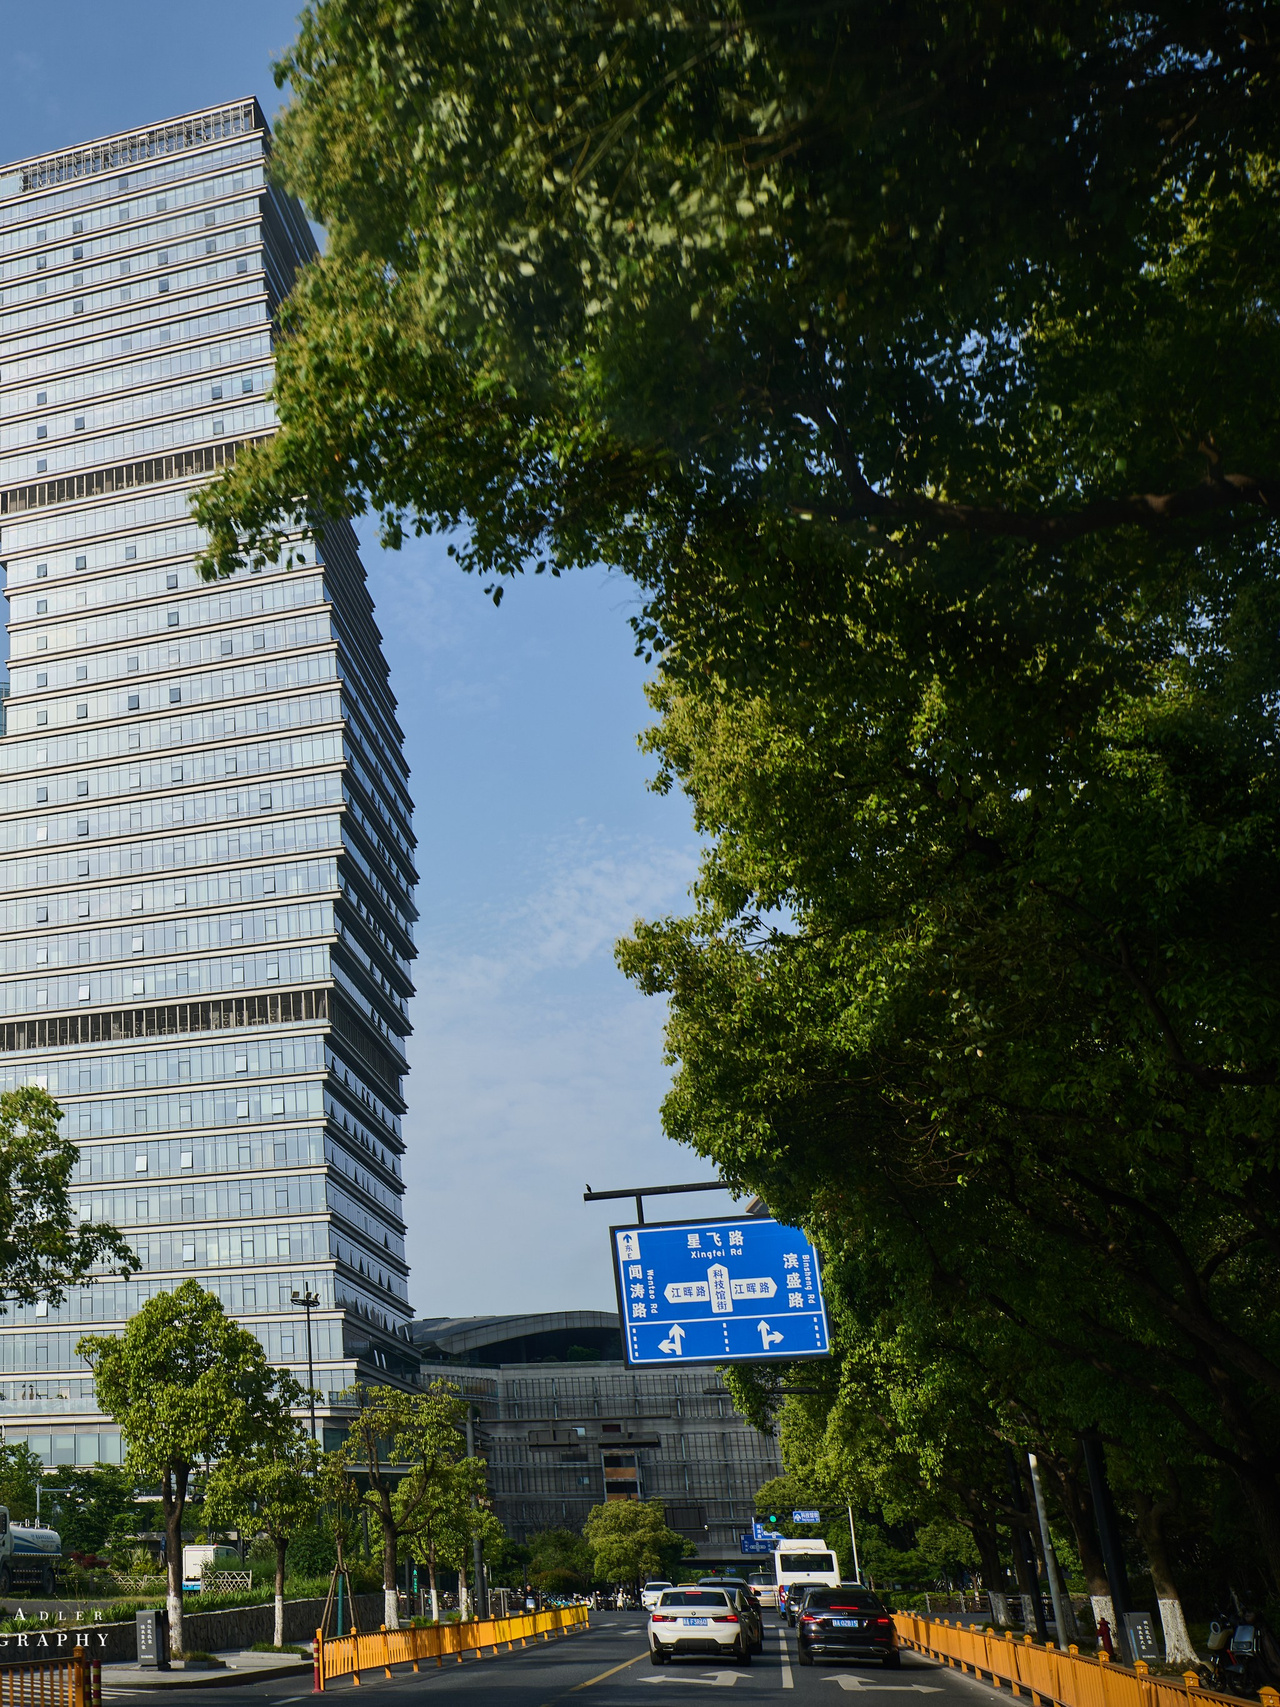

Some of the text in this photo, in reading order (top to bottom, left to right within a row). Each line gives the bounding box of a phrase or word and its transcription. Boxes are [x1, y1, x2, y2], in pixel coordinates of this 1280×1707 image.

[625, 1244, 633, 1252] 东
[687, 1230, 744, 1248] 星飞路
[690, 1248, 743, 1260] Xingfei Rd
[628, 1264, 647, 1318] 闻涛路
[646, 1269, 658, 1314] Wentao Rd
[671, 1285, 706, 1298] 江晖路
[712, 1269, 727, 1311] 科技馆街
[734, 1281, 770, 1295] 江晖路
[782, 1252, 804, 1309] 滨盛路
[802, 1254, 816, 1304] Binsheng Rd
